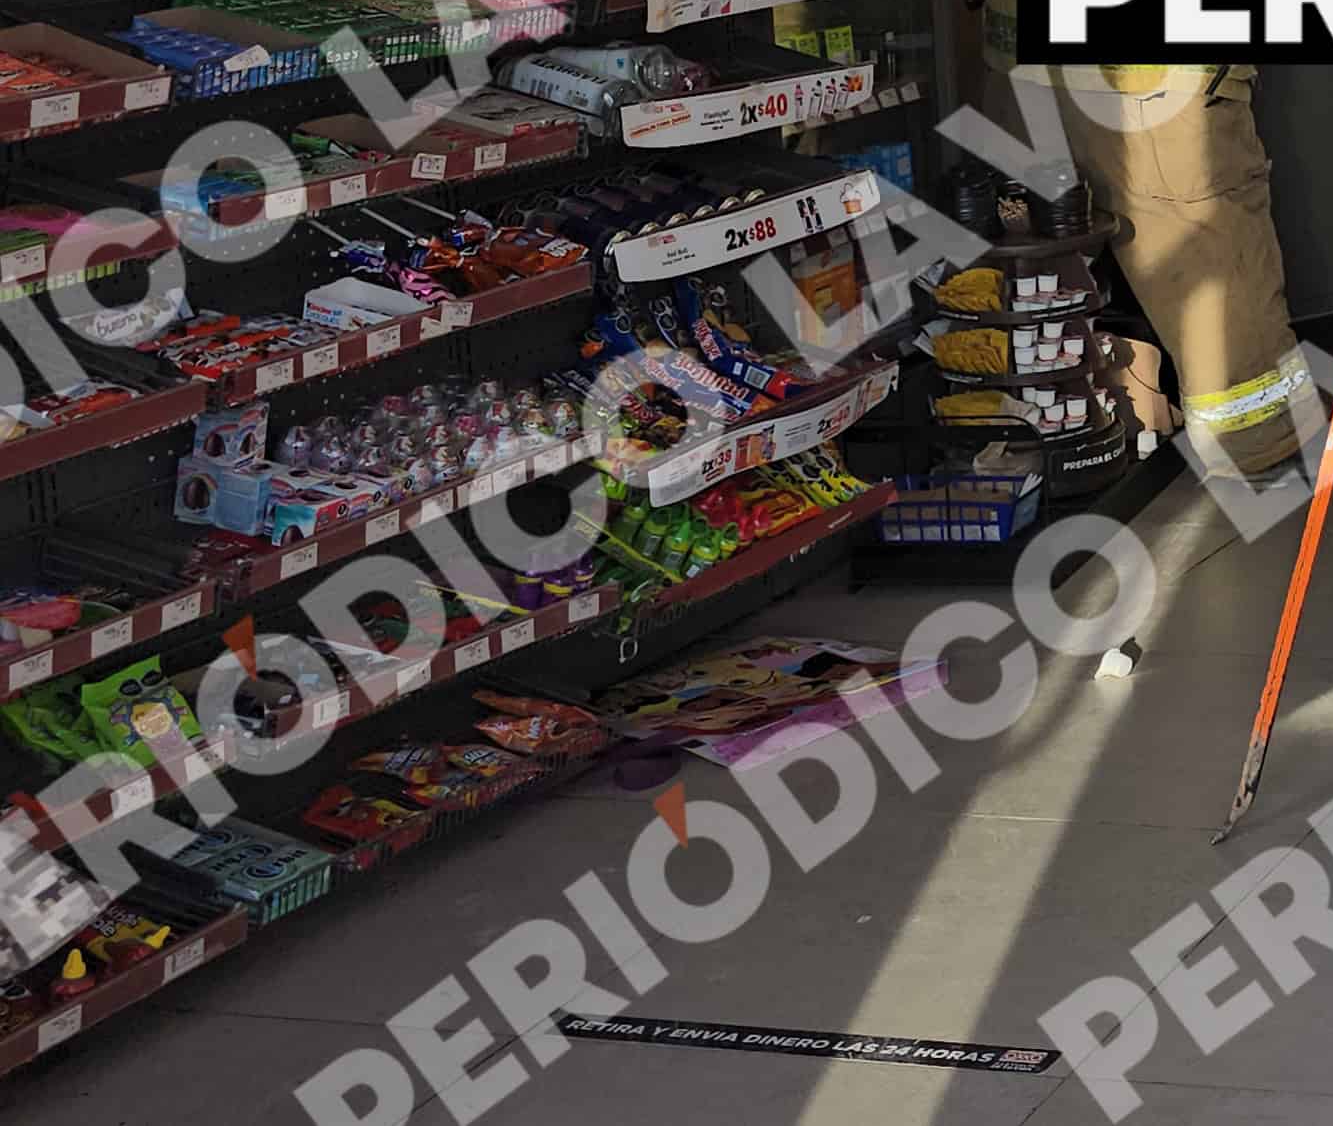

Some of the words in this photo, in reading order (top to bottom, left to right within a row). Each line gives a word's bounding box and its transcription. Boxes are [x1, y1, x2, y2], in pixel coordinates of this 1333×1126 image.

[739, 92, 788, 127] 2x$40
[724, 216, 777, 253] 2x$88
[1063, 456, 1105, 472] PREPARA
[566, 1018, 645, 1036] RETIRA
[653, 1026, 667, 1038] Y
[669, 1027, 739, 1044] ENVIA
[742, 1033, 829, 1051] DINERO
[833, 1040, 877, 1055] LAS
[881, 1043, 912, 1058] 24
[914, 1046, 995, 1064] HORAS
